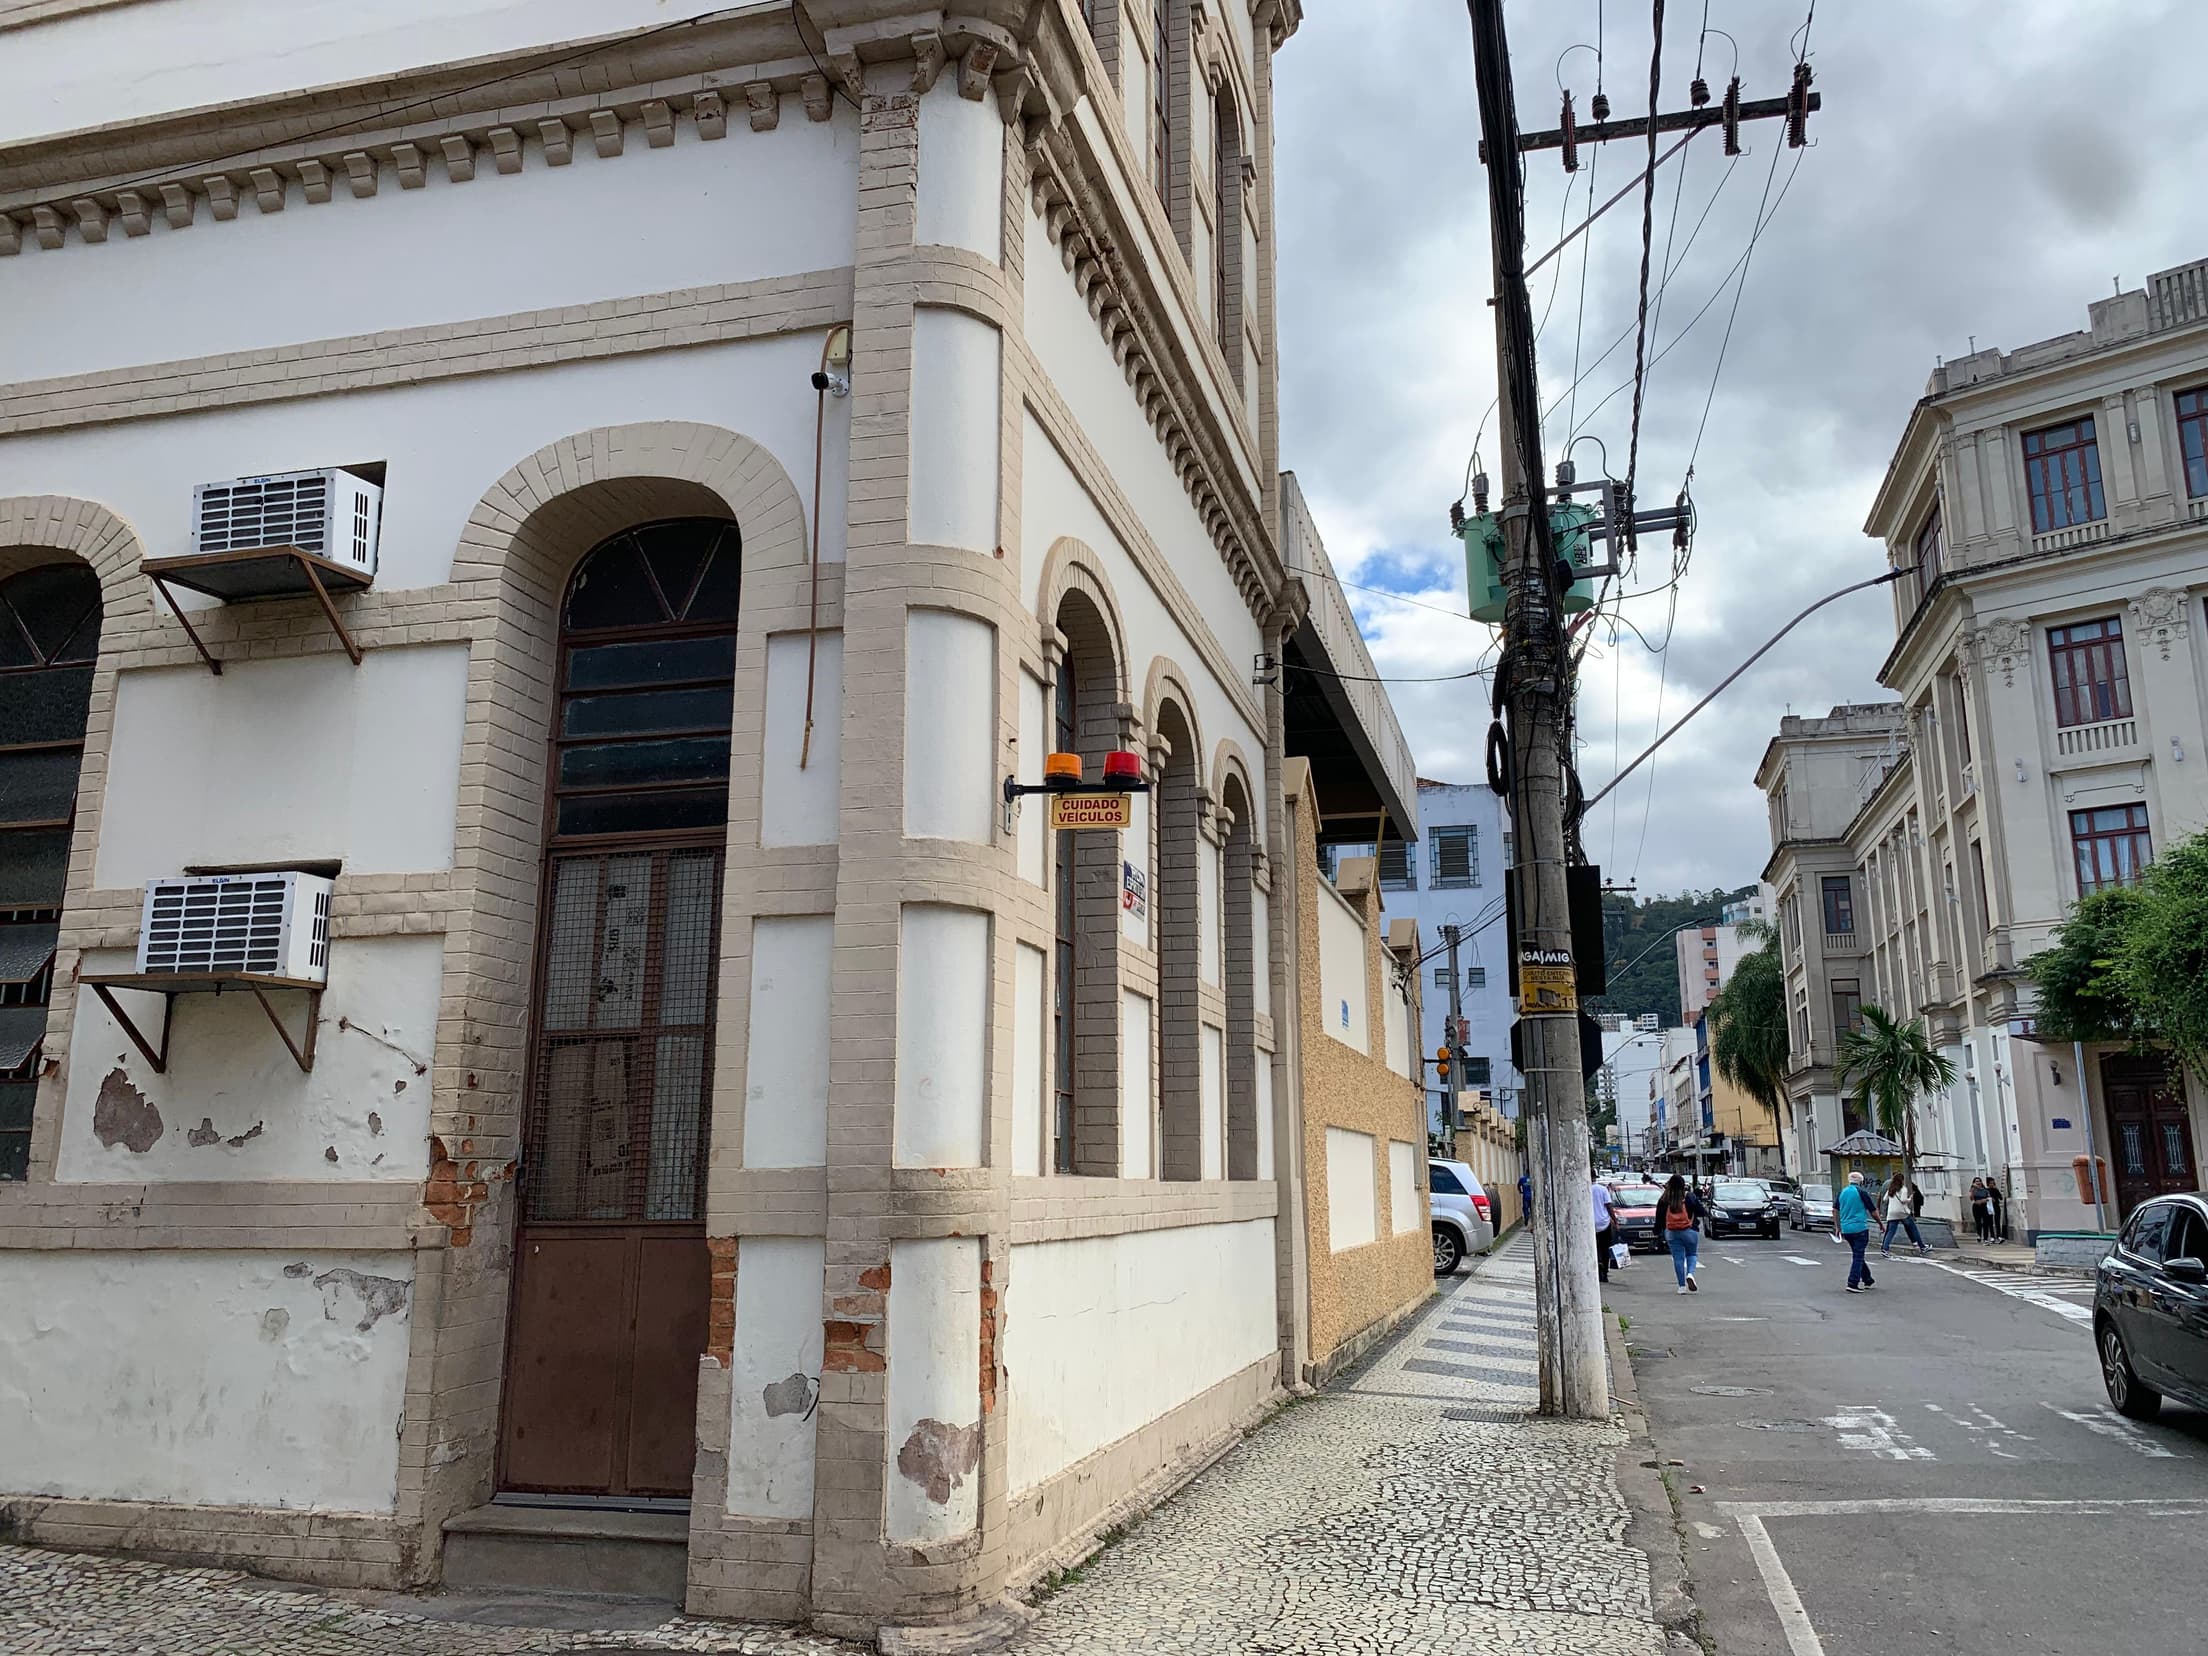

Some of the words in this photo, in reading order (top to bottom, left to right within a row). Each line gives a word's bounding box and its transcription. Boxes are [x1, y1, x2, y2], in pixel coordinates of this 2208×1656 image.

[1062, 799, 1120, 810] CUIDADO
[1058, 810, 1122, 822] VEÍCULOS
[1524, 951, 1570, 964] GASMIG
